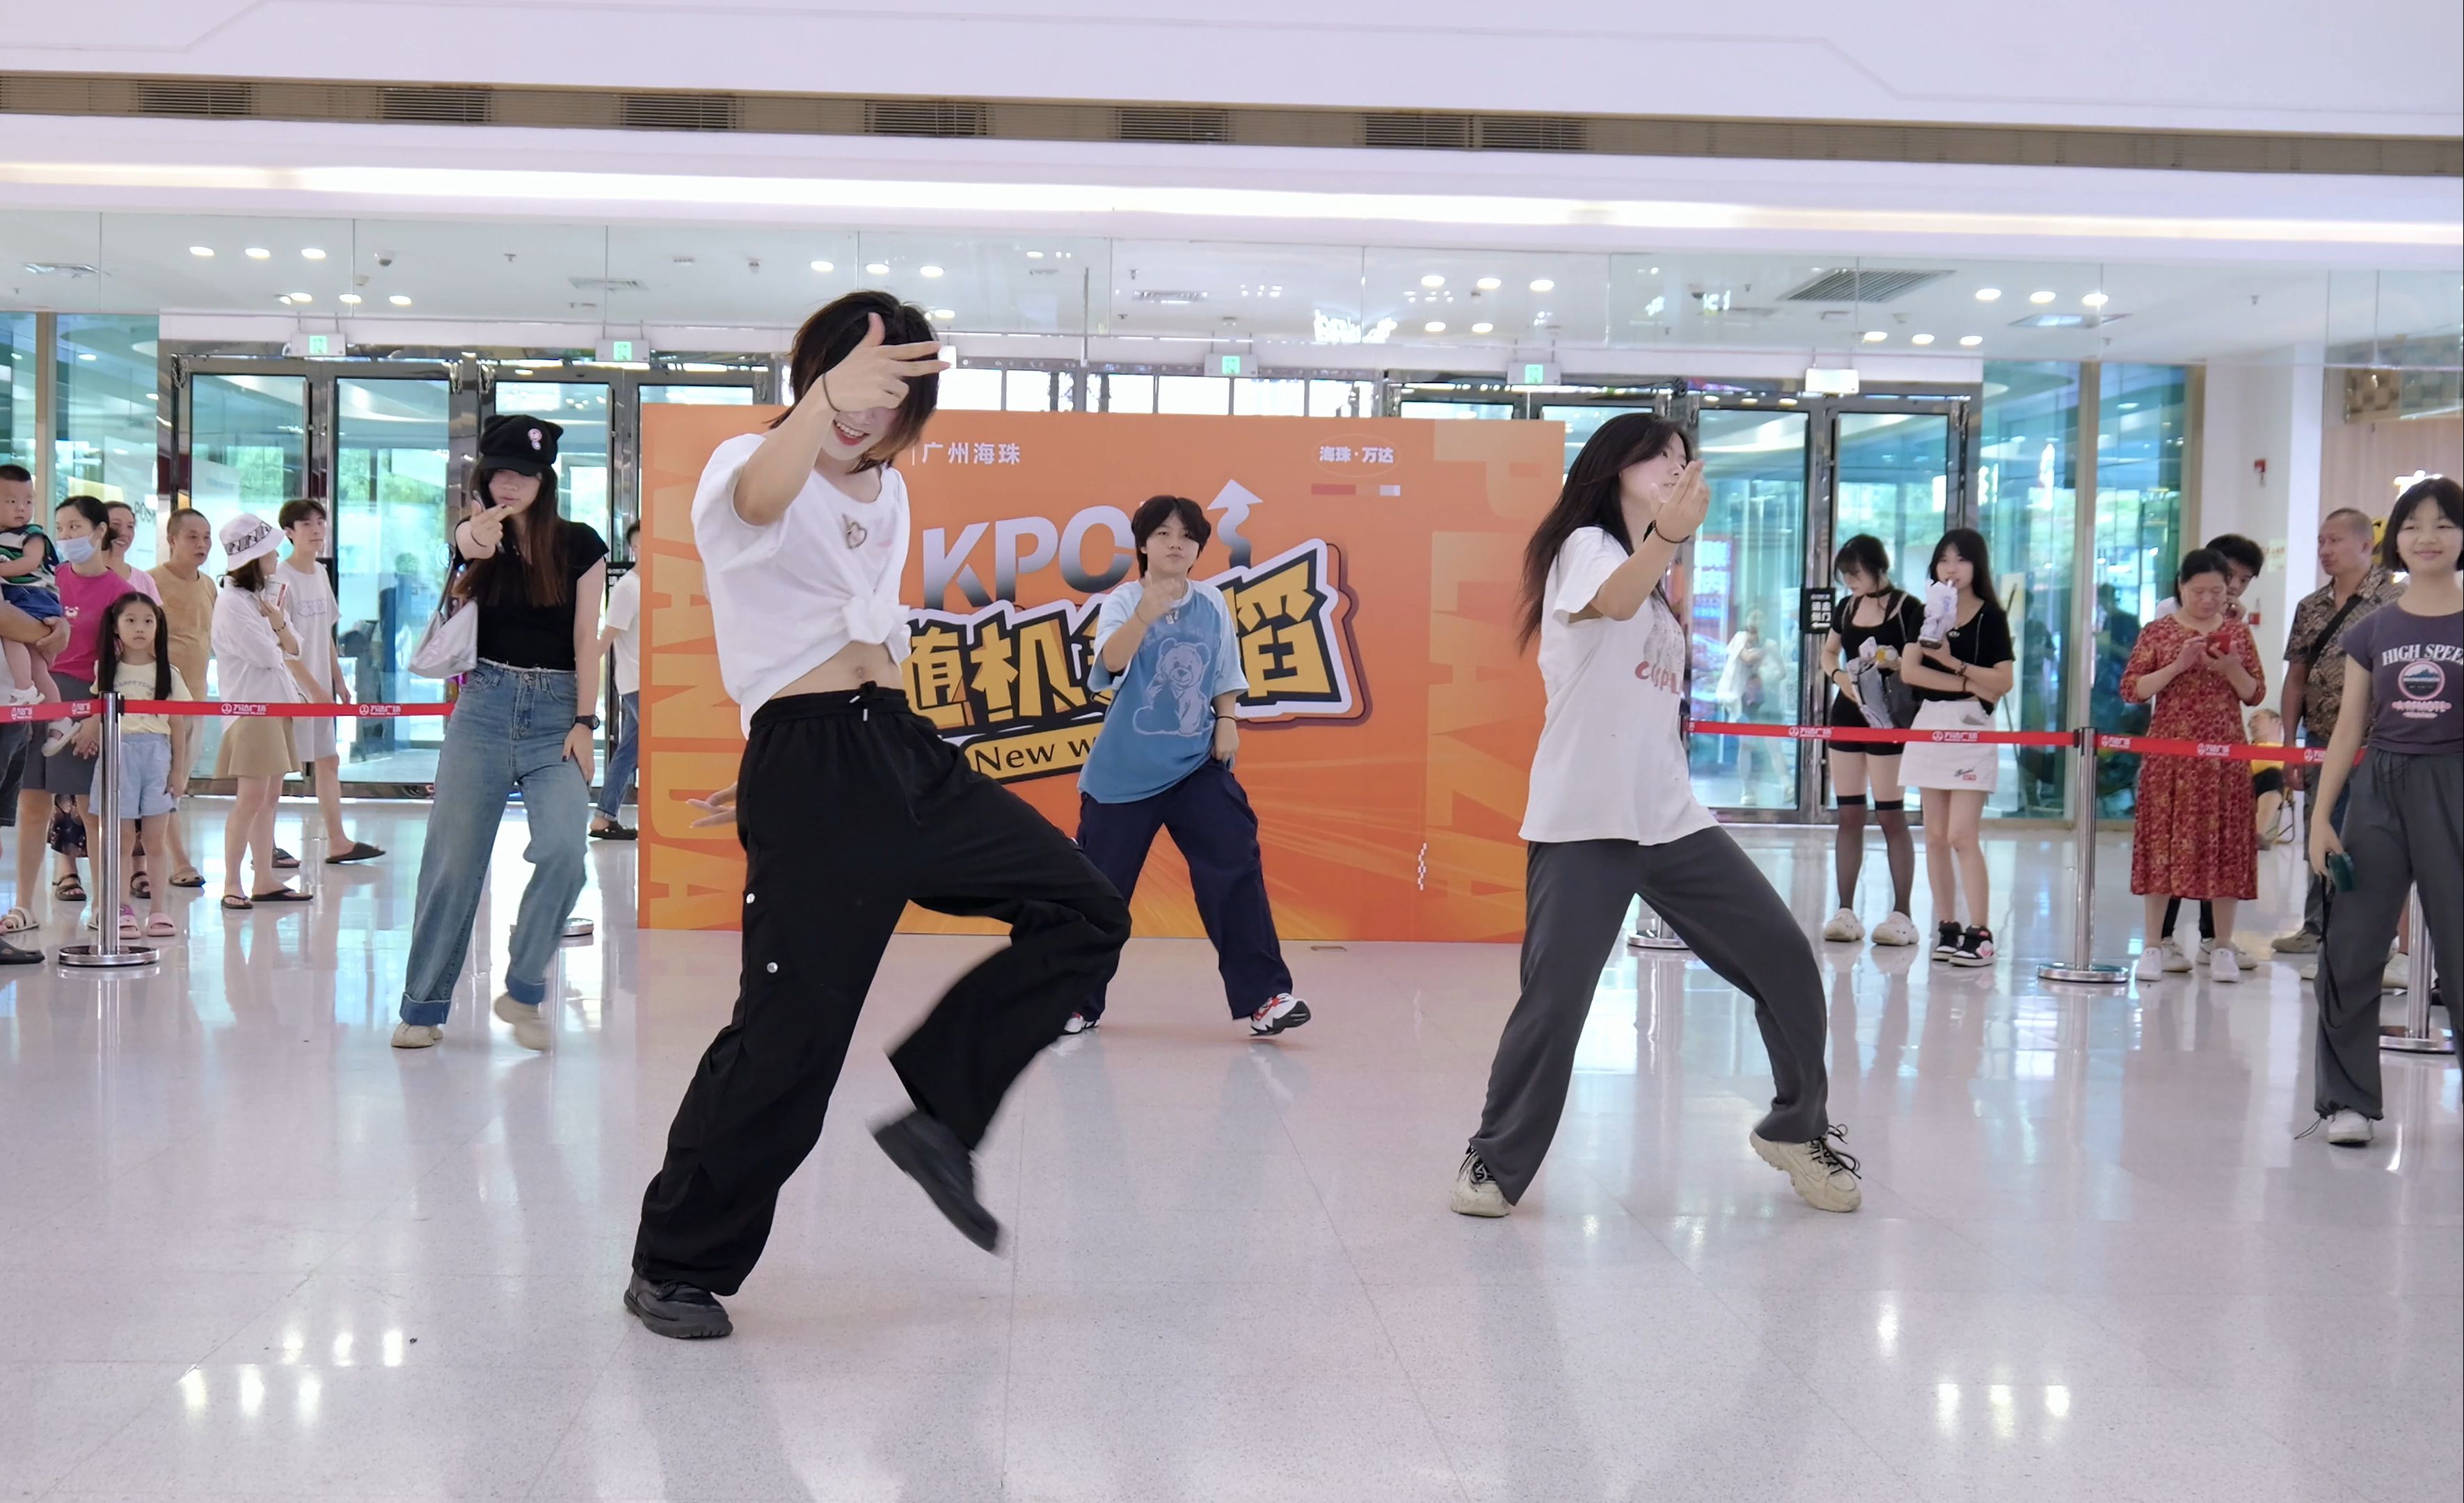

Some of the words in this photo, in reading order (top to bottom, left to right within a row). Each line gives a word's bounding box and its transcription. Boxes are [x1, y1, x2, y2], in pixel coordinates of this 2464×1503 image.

[921, 441, 1021, 466] 广州海珠
[2381, 644, 2421, 667] HIGH
[2424, 643, 2463, 666] SPEE
[975, 743, 1056, 774] New
